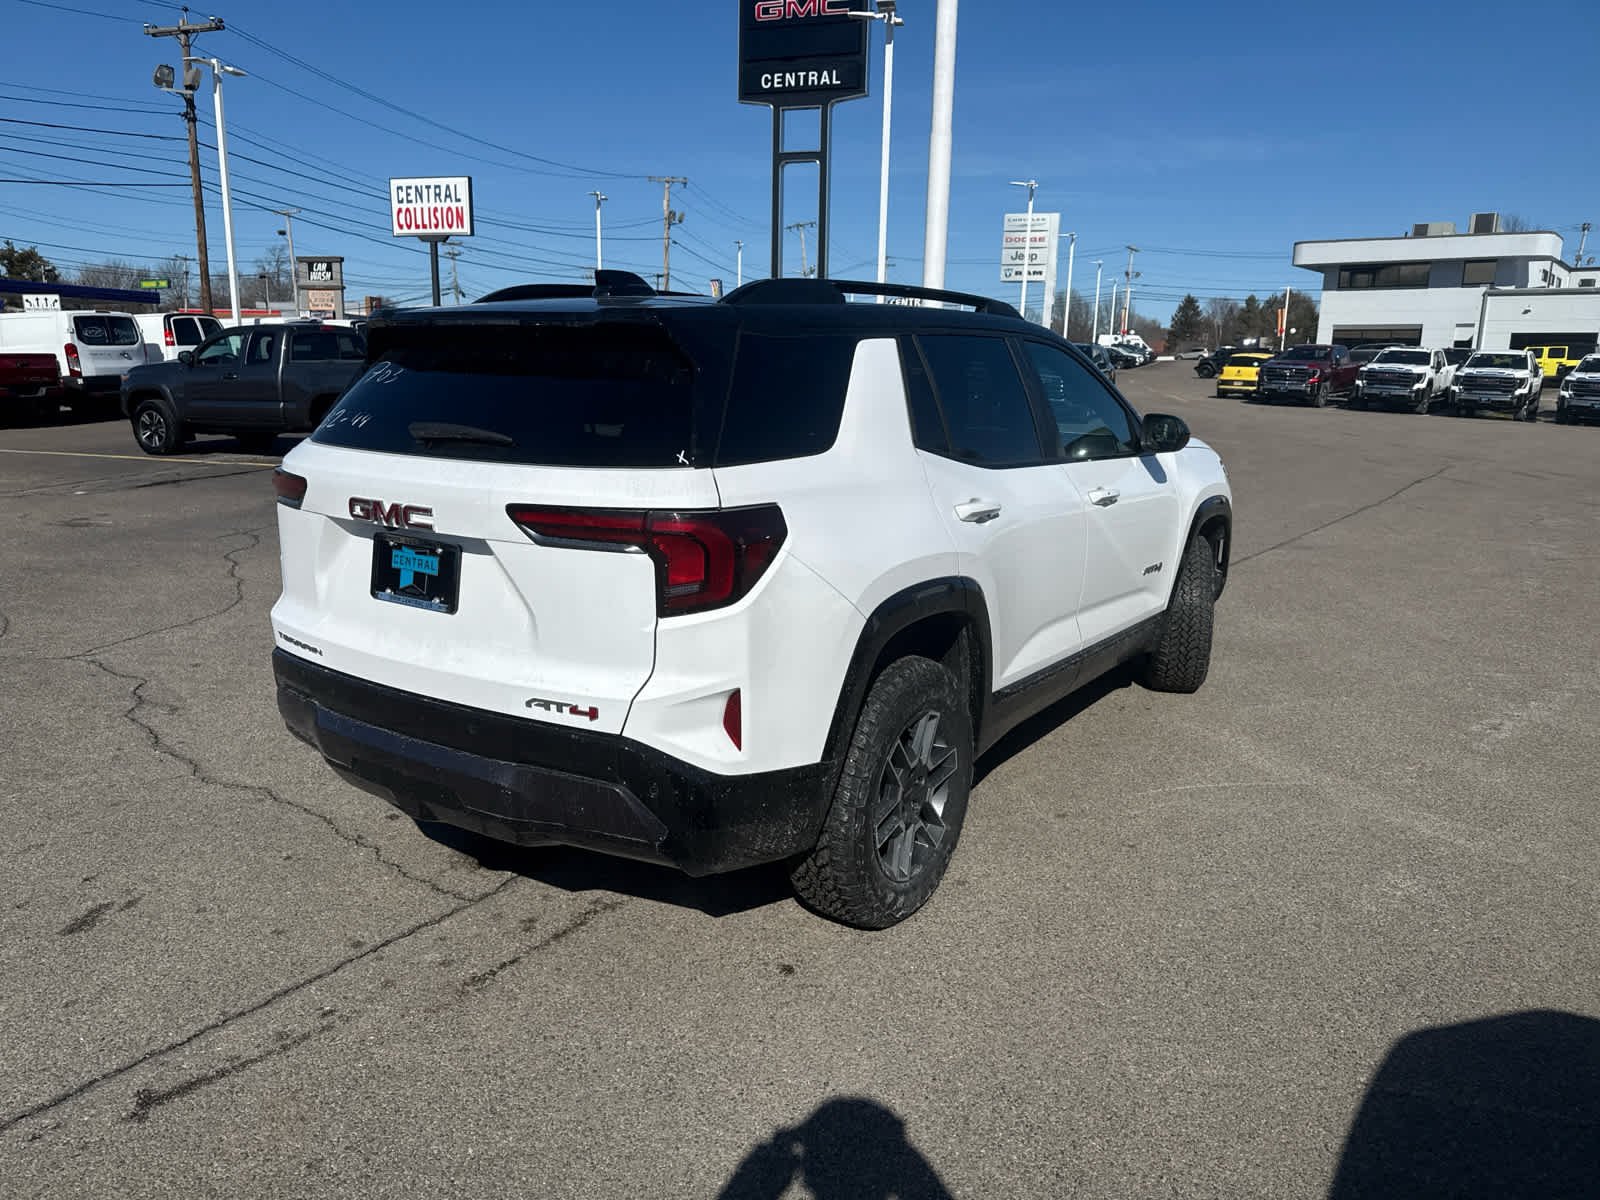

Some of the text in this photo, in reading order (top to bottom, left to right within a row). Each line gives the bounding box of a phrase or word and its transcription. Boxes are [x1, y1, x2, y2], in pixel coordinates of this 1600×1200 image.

[755, 0, 850, 21] GMC
[761, 69, 841, 88] CENTRAL
[396, 184, 462, 204] CENTRAL
[396, 206, 465, 230] COLLISION
[1010, 250, 1038, 262] Jep
[310, 271, 331, 280] WASH
[313, 262, 327, 271] CAR
[348, 496, 436, 531] GMC
[392, 552, 436, 572] CENTRAL
[525, 697, 599, 721] AT4
